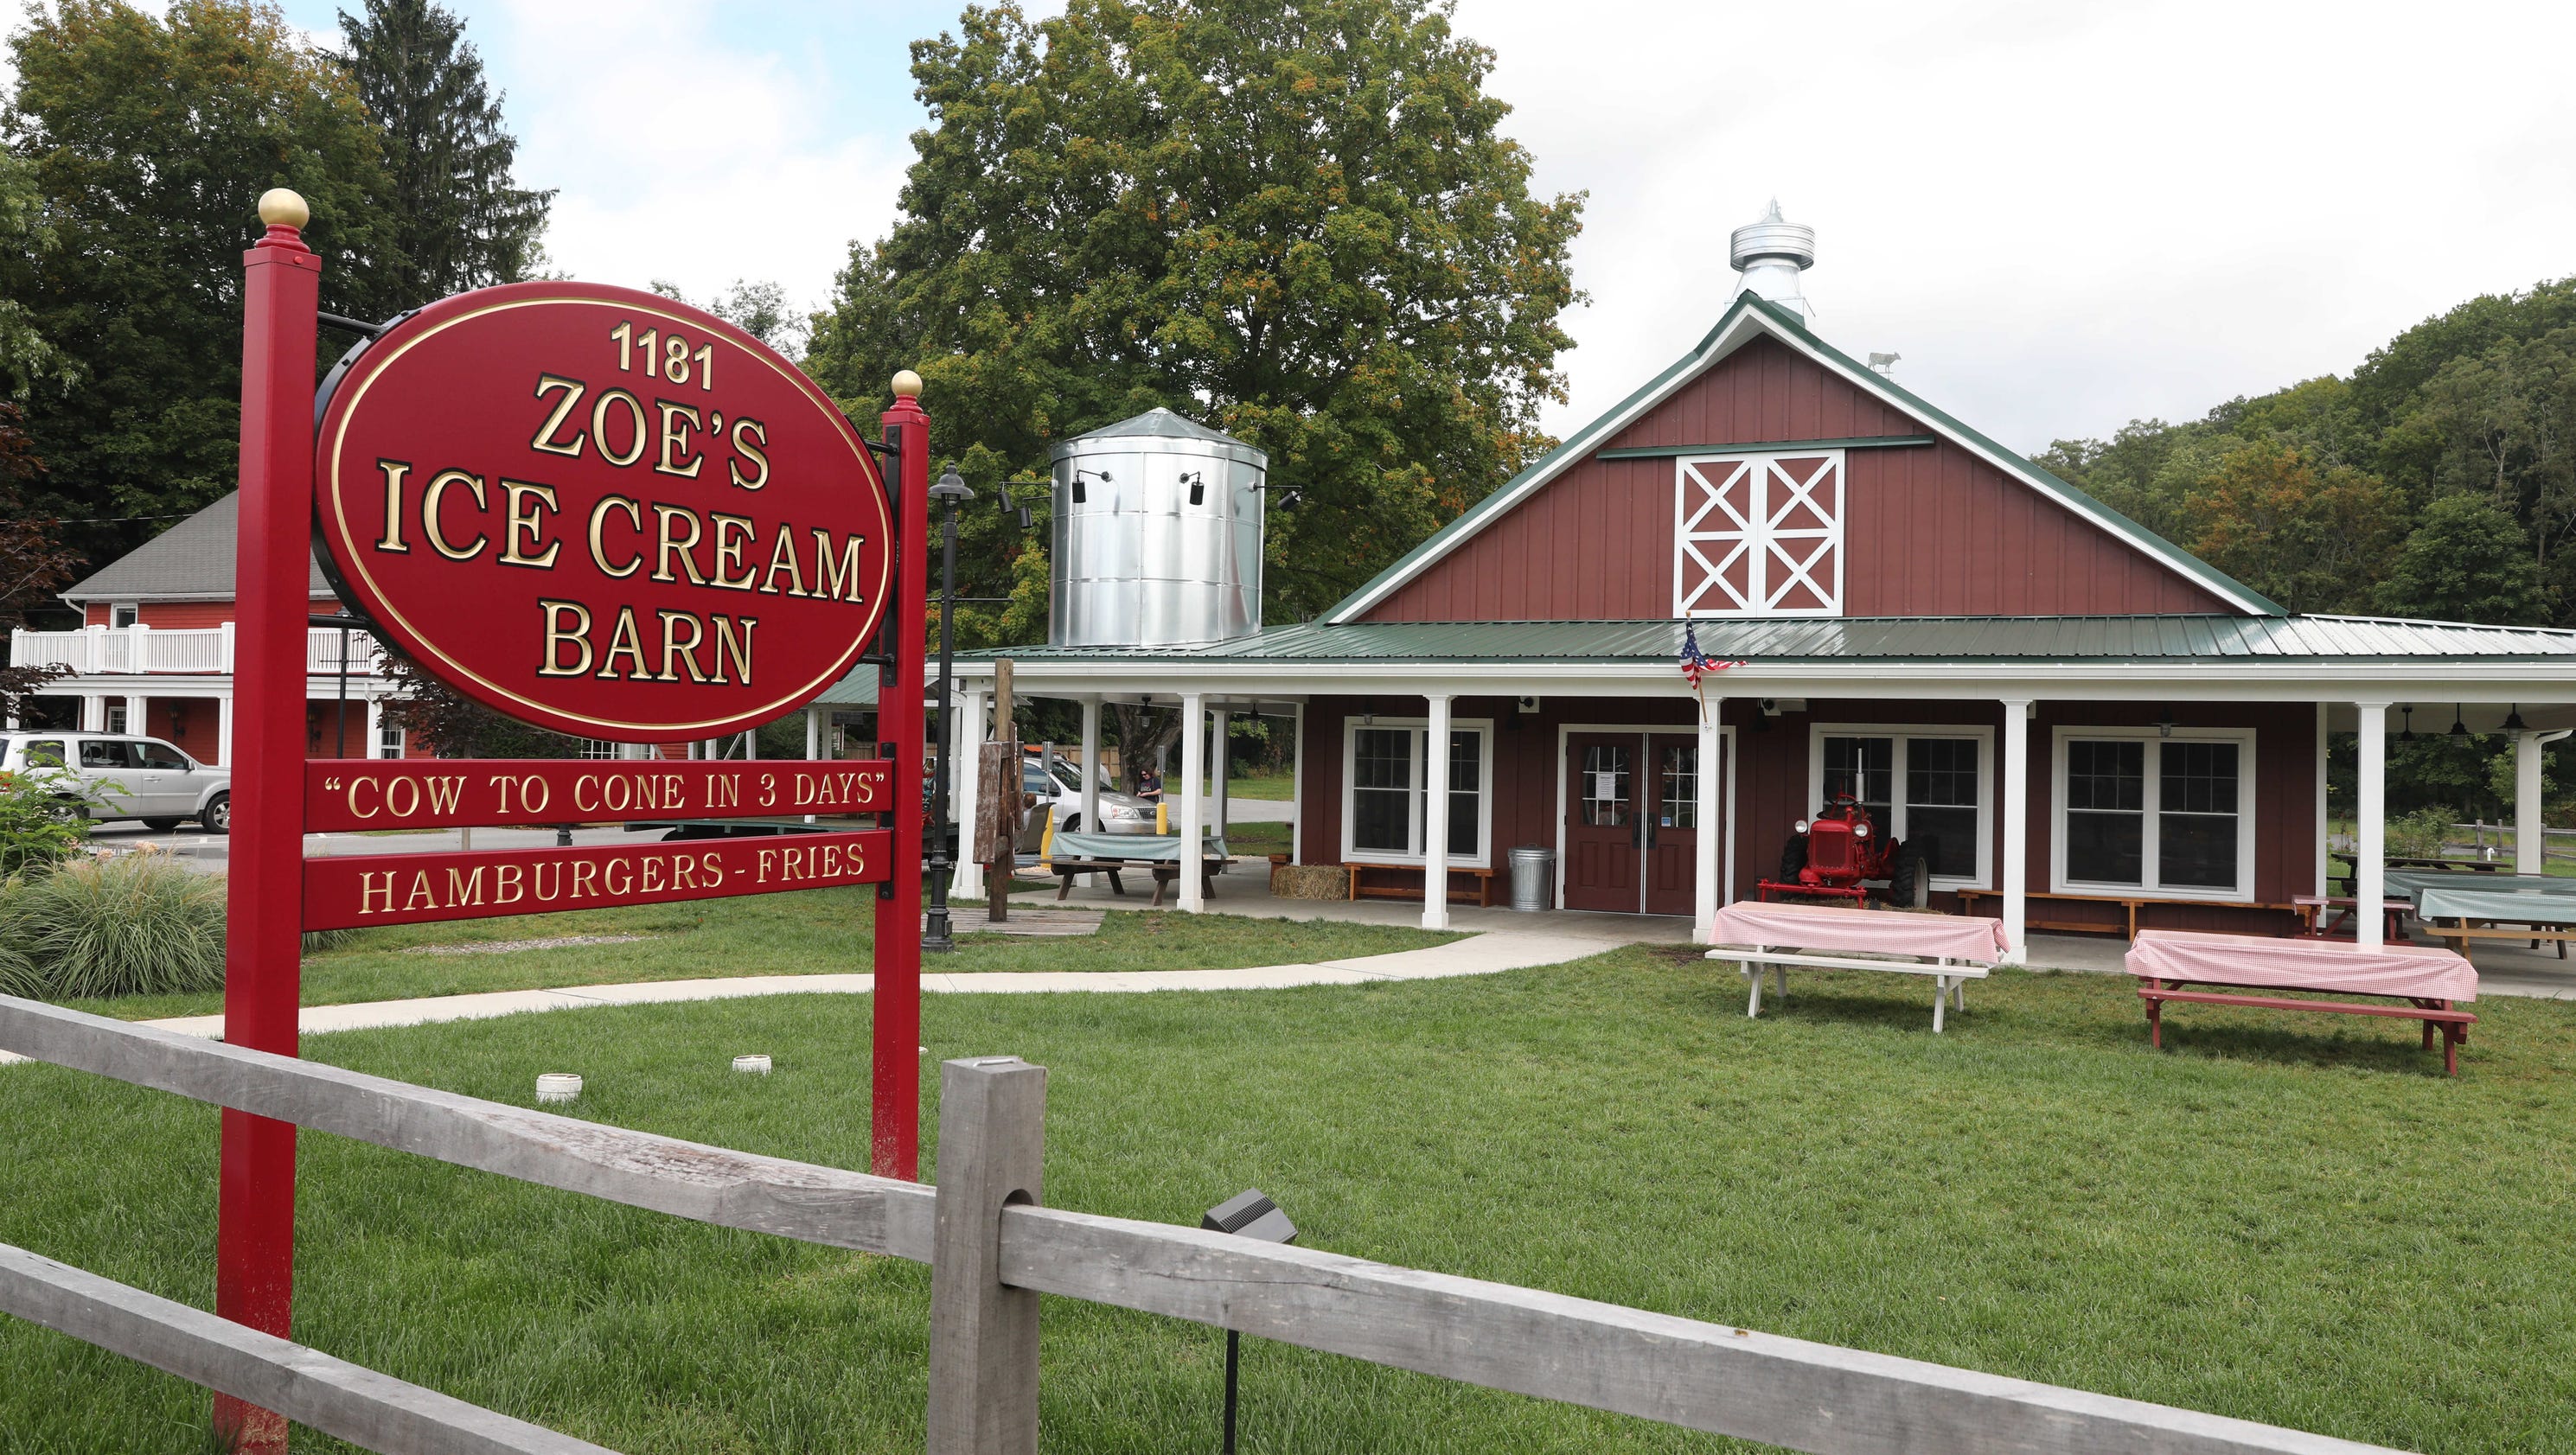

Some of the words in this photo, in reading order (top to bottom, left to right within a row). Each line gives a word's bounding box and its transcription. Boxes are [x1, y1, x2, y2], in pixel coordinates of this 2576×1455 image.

[610, 321, 713, 392] 1181
[531, 374, 770, 491] ZOE’S
[376, 461, 561, 569] ICE
[588, 495, 865, 603] CREAM
[537, 600, 758, 686] BARN
[489, 775, 549, 814] TO
[574, 774, 686, 812] CONE
[705, 774, 741, 808] IN
[758, 773, 777, 807] 3
